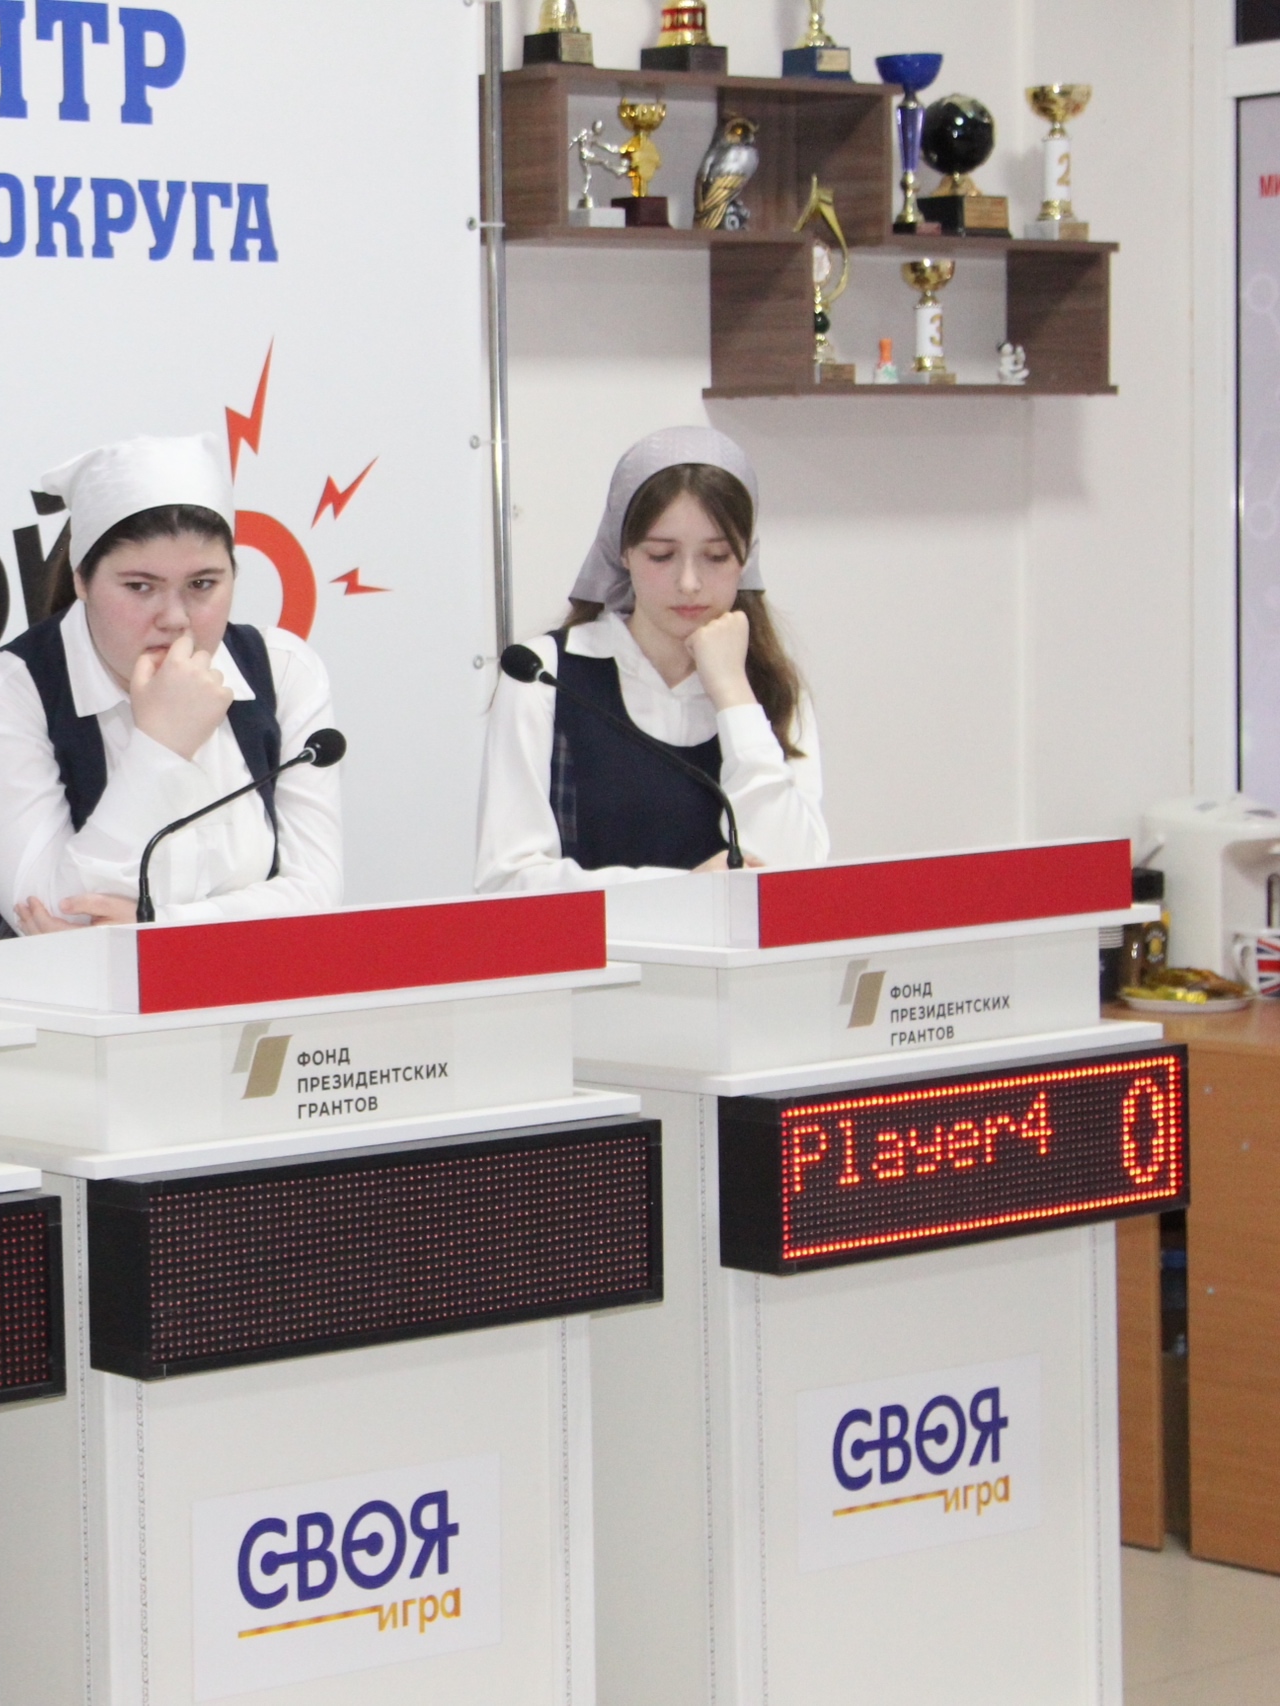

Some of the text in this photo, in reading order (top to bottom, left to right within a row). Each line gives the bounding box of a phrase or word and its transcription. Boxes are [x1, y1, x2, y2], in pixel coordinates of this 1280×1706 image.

[890, 981, 933, 999] ФОНД
[890, 995, 1010, 1022] ПРЕЗИДЕНТСКИХ
[891, 1025, 954, 1046] ГРАНТОВ
[297, 1047, 351, 1067] ФОНД
[297, 1062, 449, 1094] ПРЕЗИДЕНТСКИХ
[298, 1096, 378, 1119] ГРАНТОВ
[791, 1077, 1164, 1193] Player4 0
[832, 1387, 1008, 1491] СВОЯ
[943, 1475, 1011, 1515] игра
[237, 1490, 459, 1609] СВОЯ
[377, 1588, 461, 1633] игра
